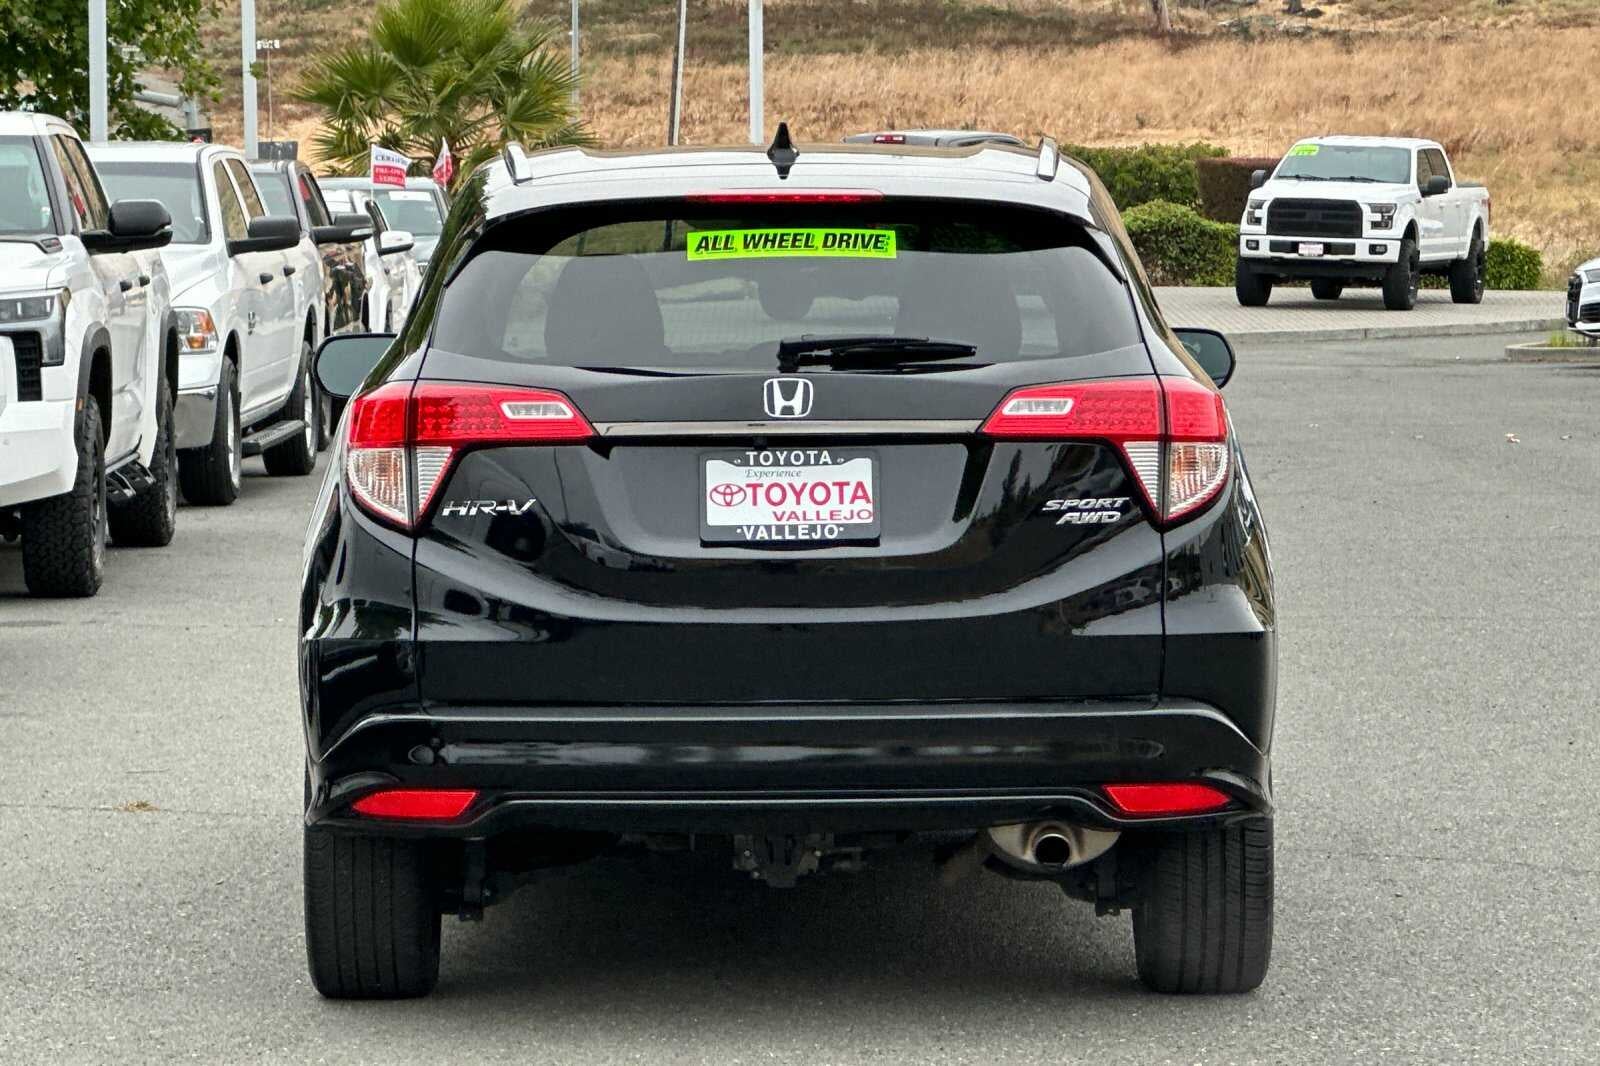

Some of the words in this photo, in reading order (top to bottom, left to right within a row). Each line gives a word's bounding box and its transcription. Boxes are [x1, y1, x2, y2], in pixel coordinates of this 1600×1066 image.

[694, 233, 737, 254] ALL
[742, 232, 817, 252] WHEEL
[821, 232, 890, 252] DRIVE
[745, 450, 832, 466] TOYOTA
[744, 468, 802, 479] Experience
[745, 481, 873, 507] TOYOTA
[441, 499, 537, 516] HR-V
[1042, 497, 1130, 511] SPORT
[772, 509, 873, 522] VALLEJO
[1056, 511, 1121, 525] AWD
[742, 524, 839, 540] VALLEJO
